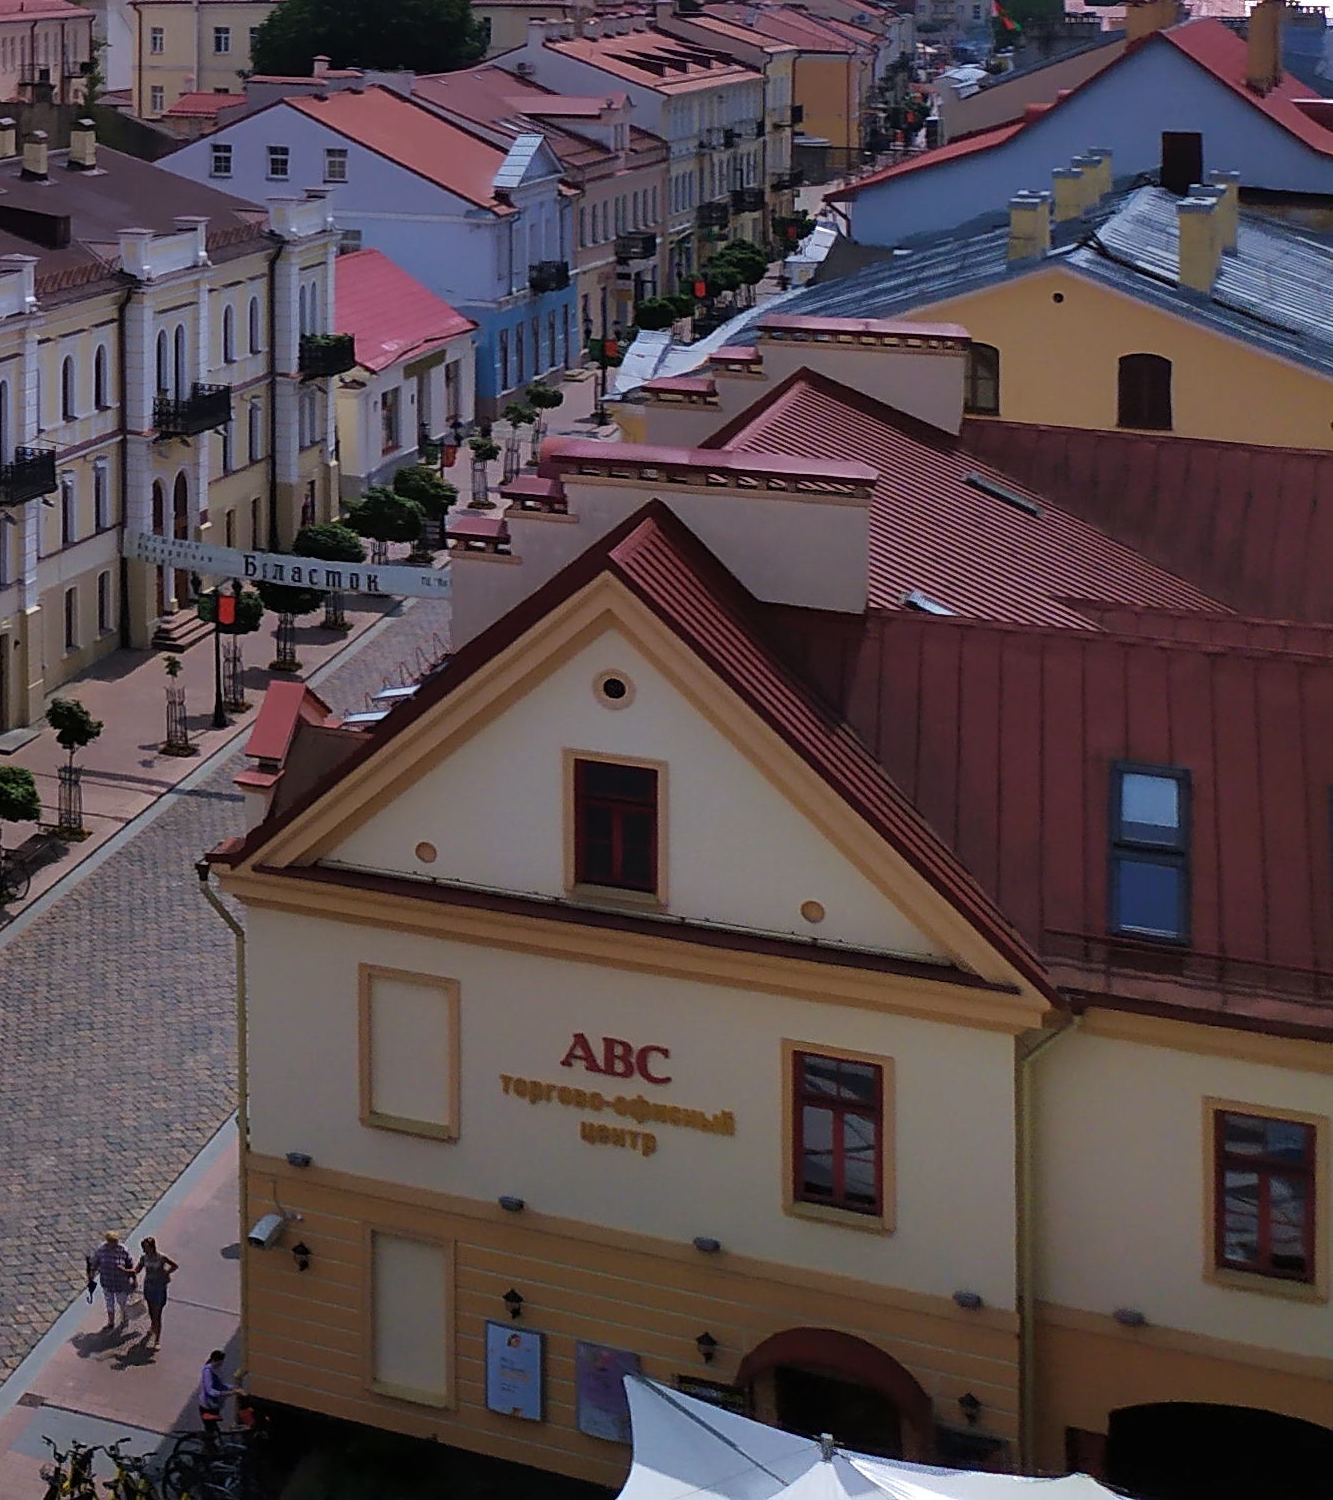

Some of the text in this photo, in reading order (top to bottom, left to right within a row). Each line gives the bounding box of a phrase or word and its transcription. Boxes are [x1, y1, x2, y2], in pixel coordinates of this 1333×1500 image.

[243, 554, 380, 591] Біласток
[499, 1074, 736, 1137] торгово-офисный
[580, 1121, 657, 1157] центр
